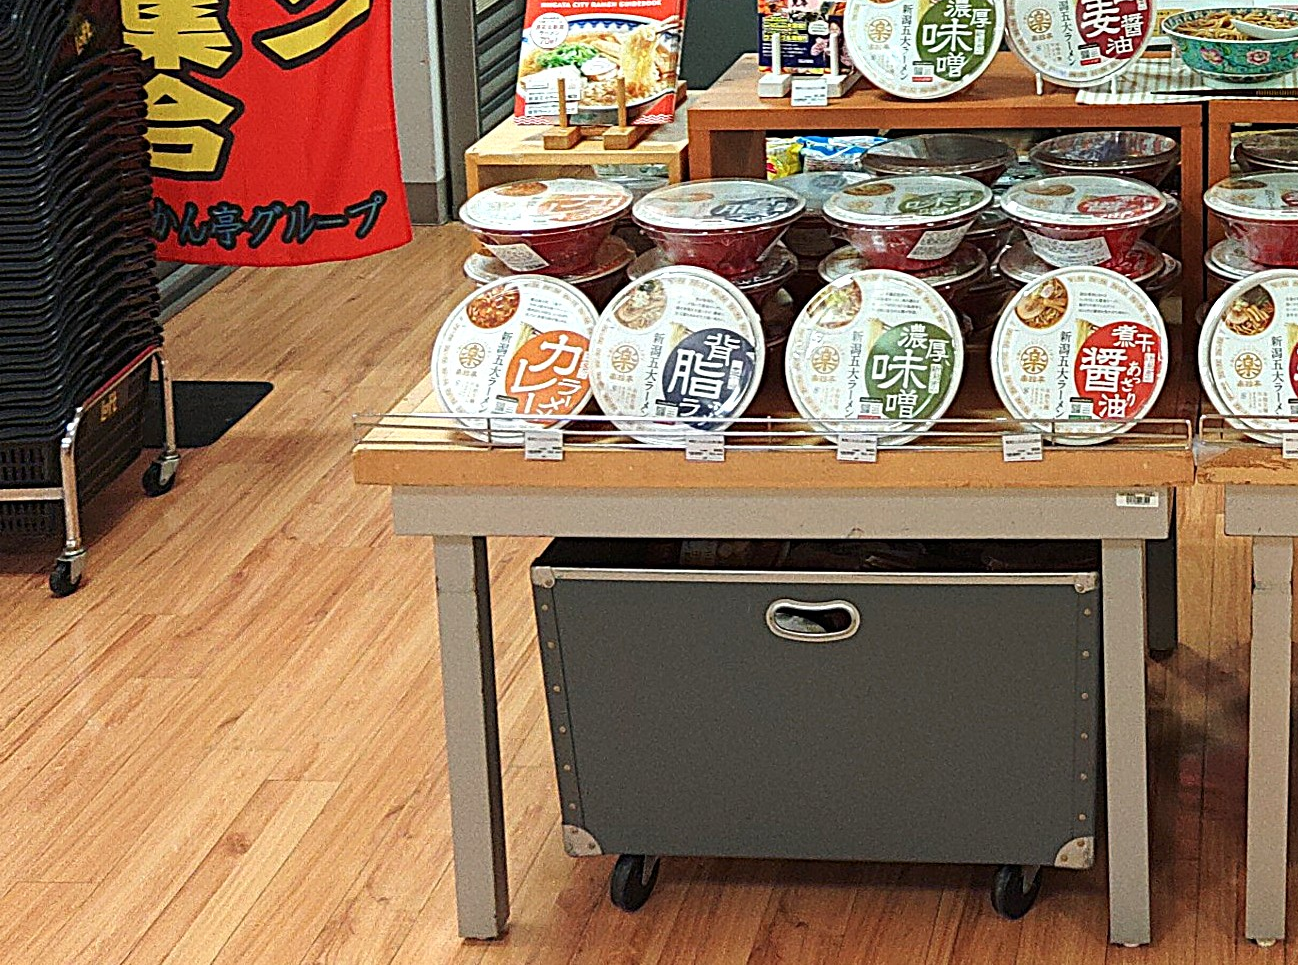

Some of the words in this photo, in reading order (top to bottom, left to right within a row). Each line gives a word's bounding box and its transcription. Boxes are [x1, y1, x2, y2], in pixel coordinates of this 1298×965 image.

[900, 4, 913, 81] 新潟五大ラーメン
[922, 18, 973, 77] 味噌
[1106, 12, 1144, 54] 醤油
[152, 190, 388, 250] かん亭グループ
[668, 333, 741, 399] 背脂
[845, 331, 863, 419] 新潟五大ラーメン
[872, 349, 928, 419] 味噌
[1055, 331, 1072, 419] 新潟五大ラーメン
[1120, 361, 1141, 407] あっさり
